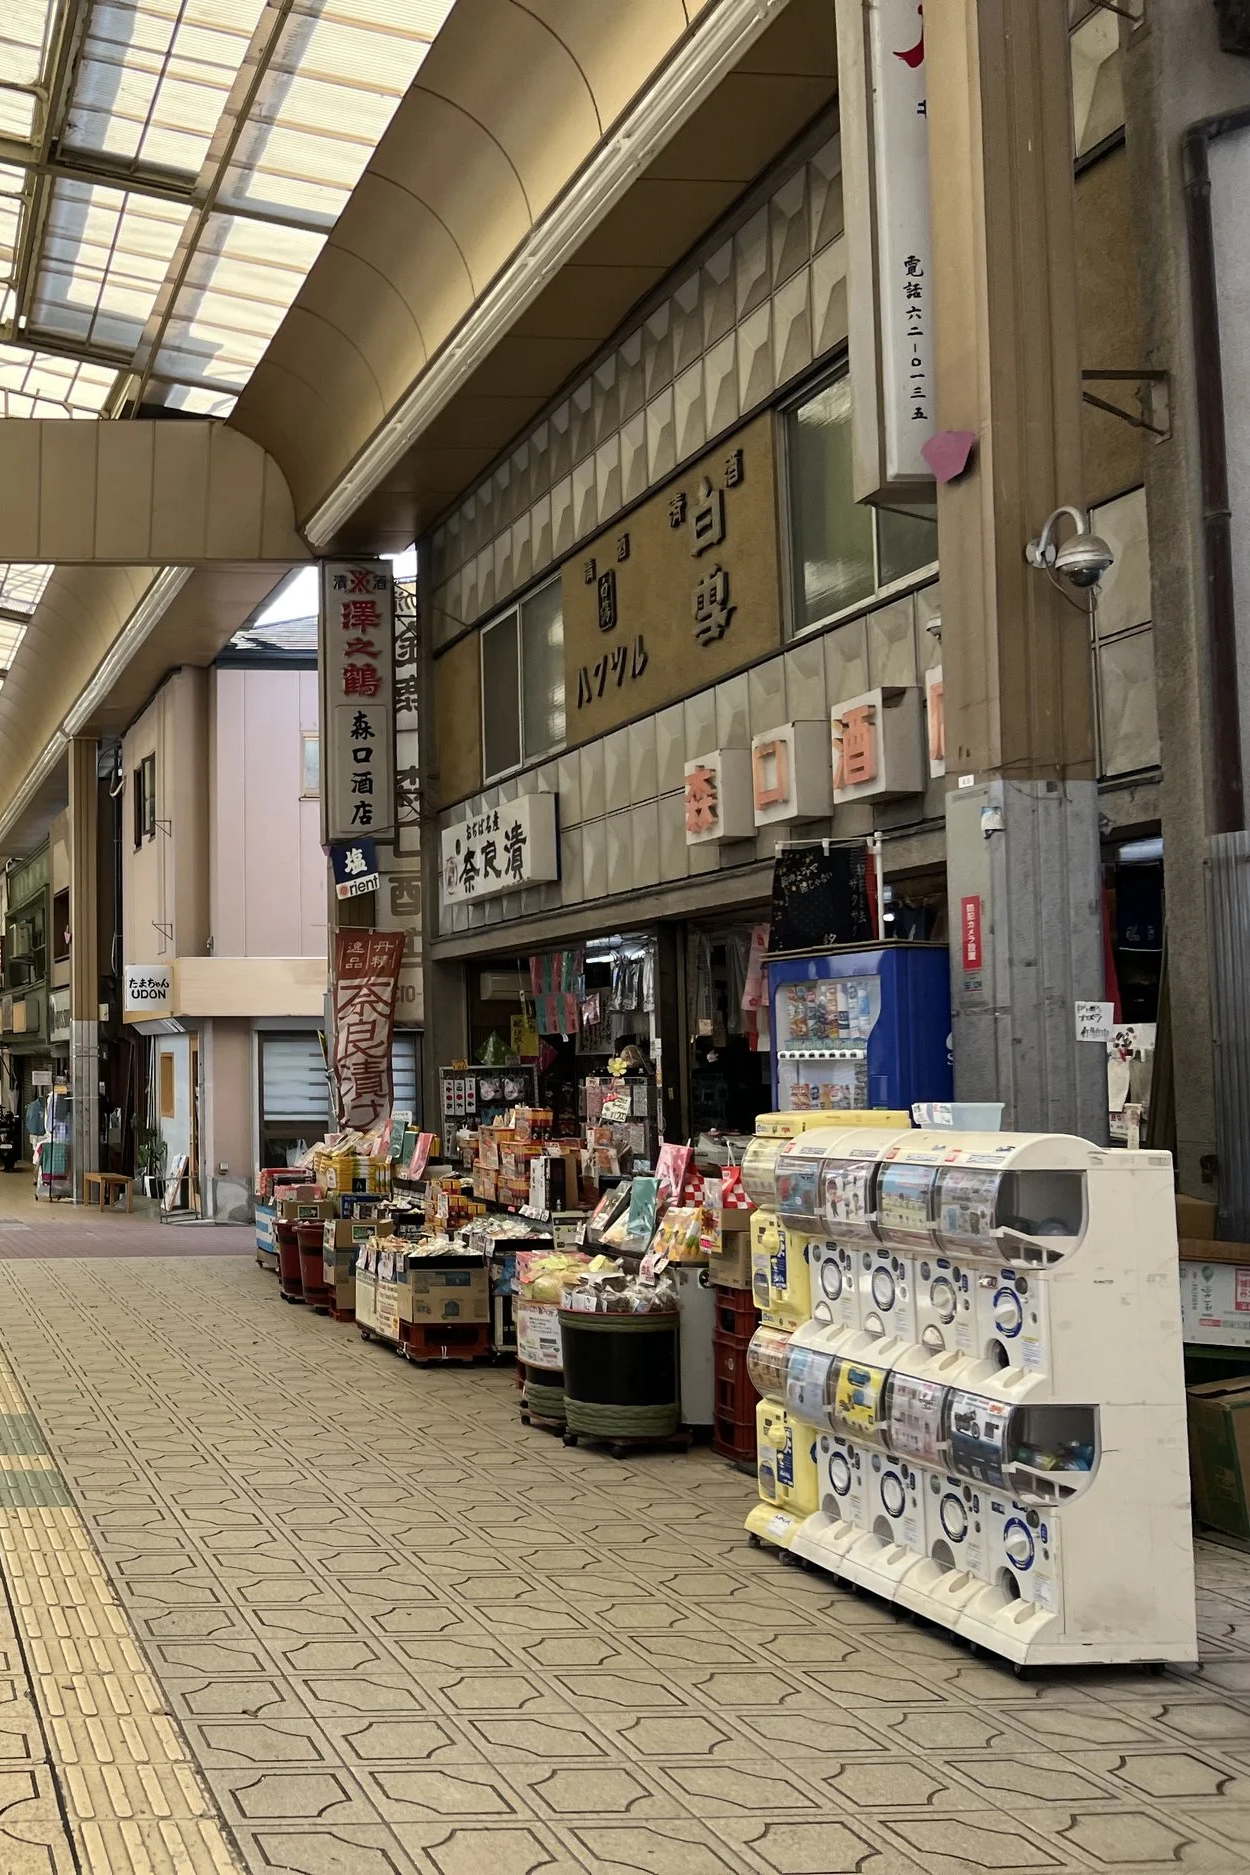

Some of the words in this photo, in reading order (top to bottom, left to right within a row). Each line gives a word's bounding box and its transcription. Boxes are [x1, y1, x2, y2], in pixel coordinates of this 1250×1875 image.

[350, 710, 375, 826] 森口酒店
[344, 848, 368, 875] 塩
[459, 820, 527, 893] 奈良漬
[129, 978, 169, 988] たまちゃん
[131, 989, 166, 999] UDON
